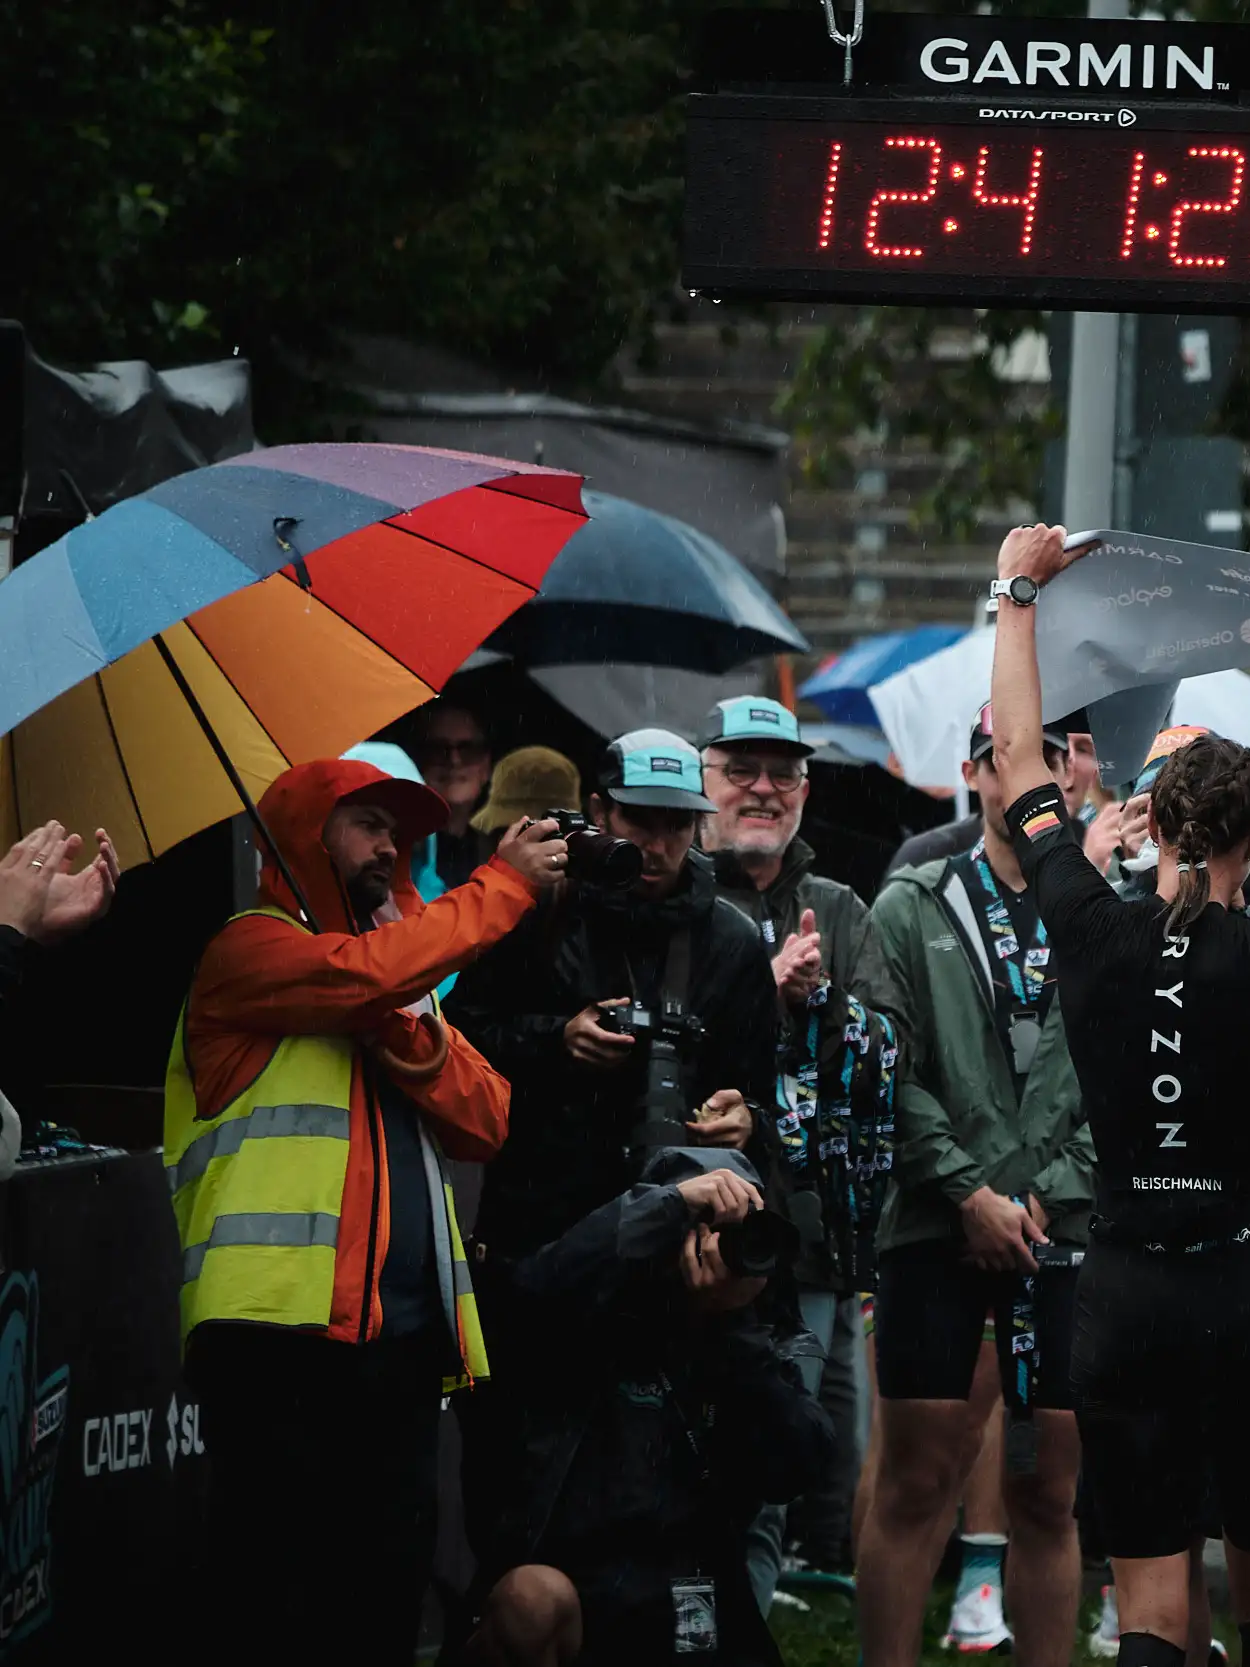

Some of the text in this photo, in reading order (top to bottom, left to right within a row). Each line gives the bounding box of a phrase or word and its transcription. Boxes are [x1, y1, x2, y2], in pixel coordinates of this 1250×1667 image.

[919, 37, 1215, 90] GARMIN
[978, 107, 1114, 126] DATASPORT
[1132, 1176, 1223, 1192] REISCHMANN
[83, 1408, 154, 1477] CADEX
